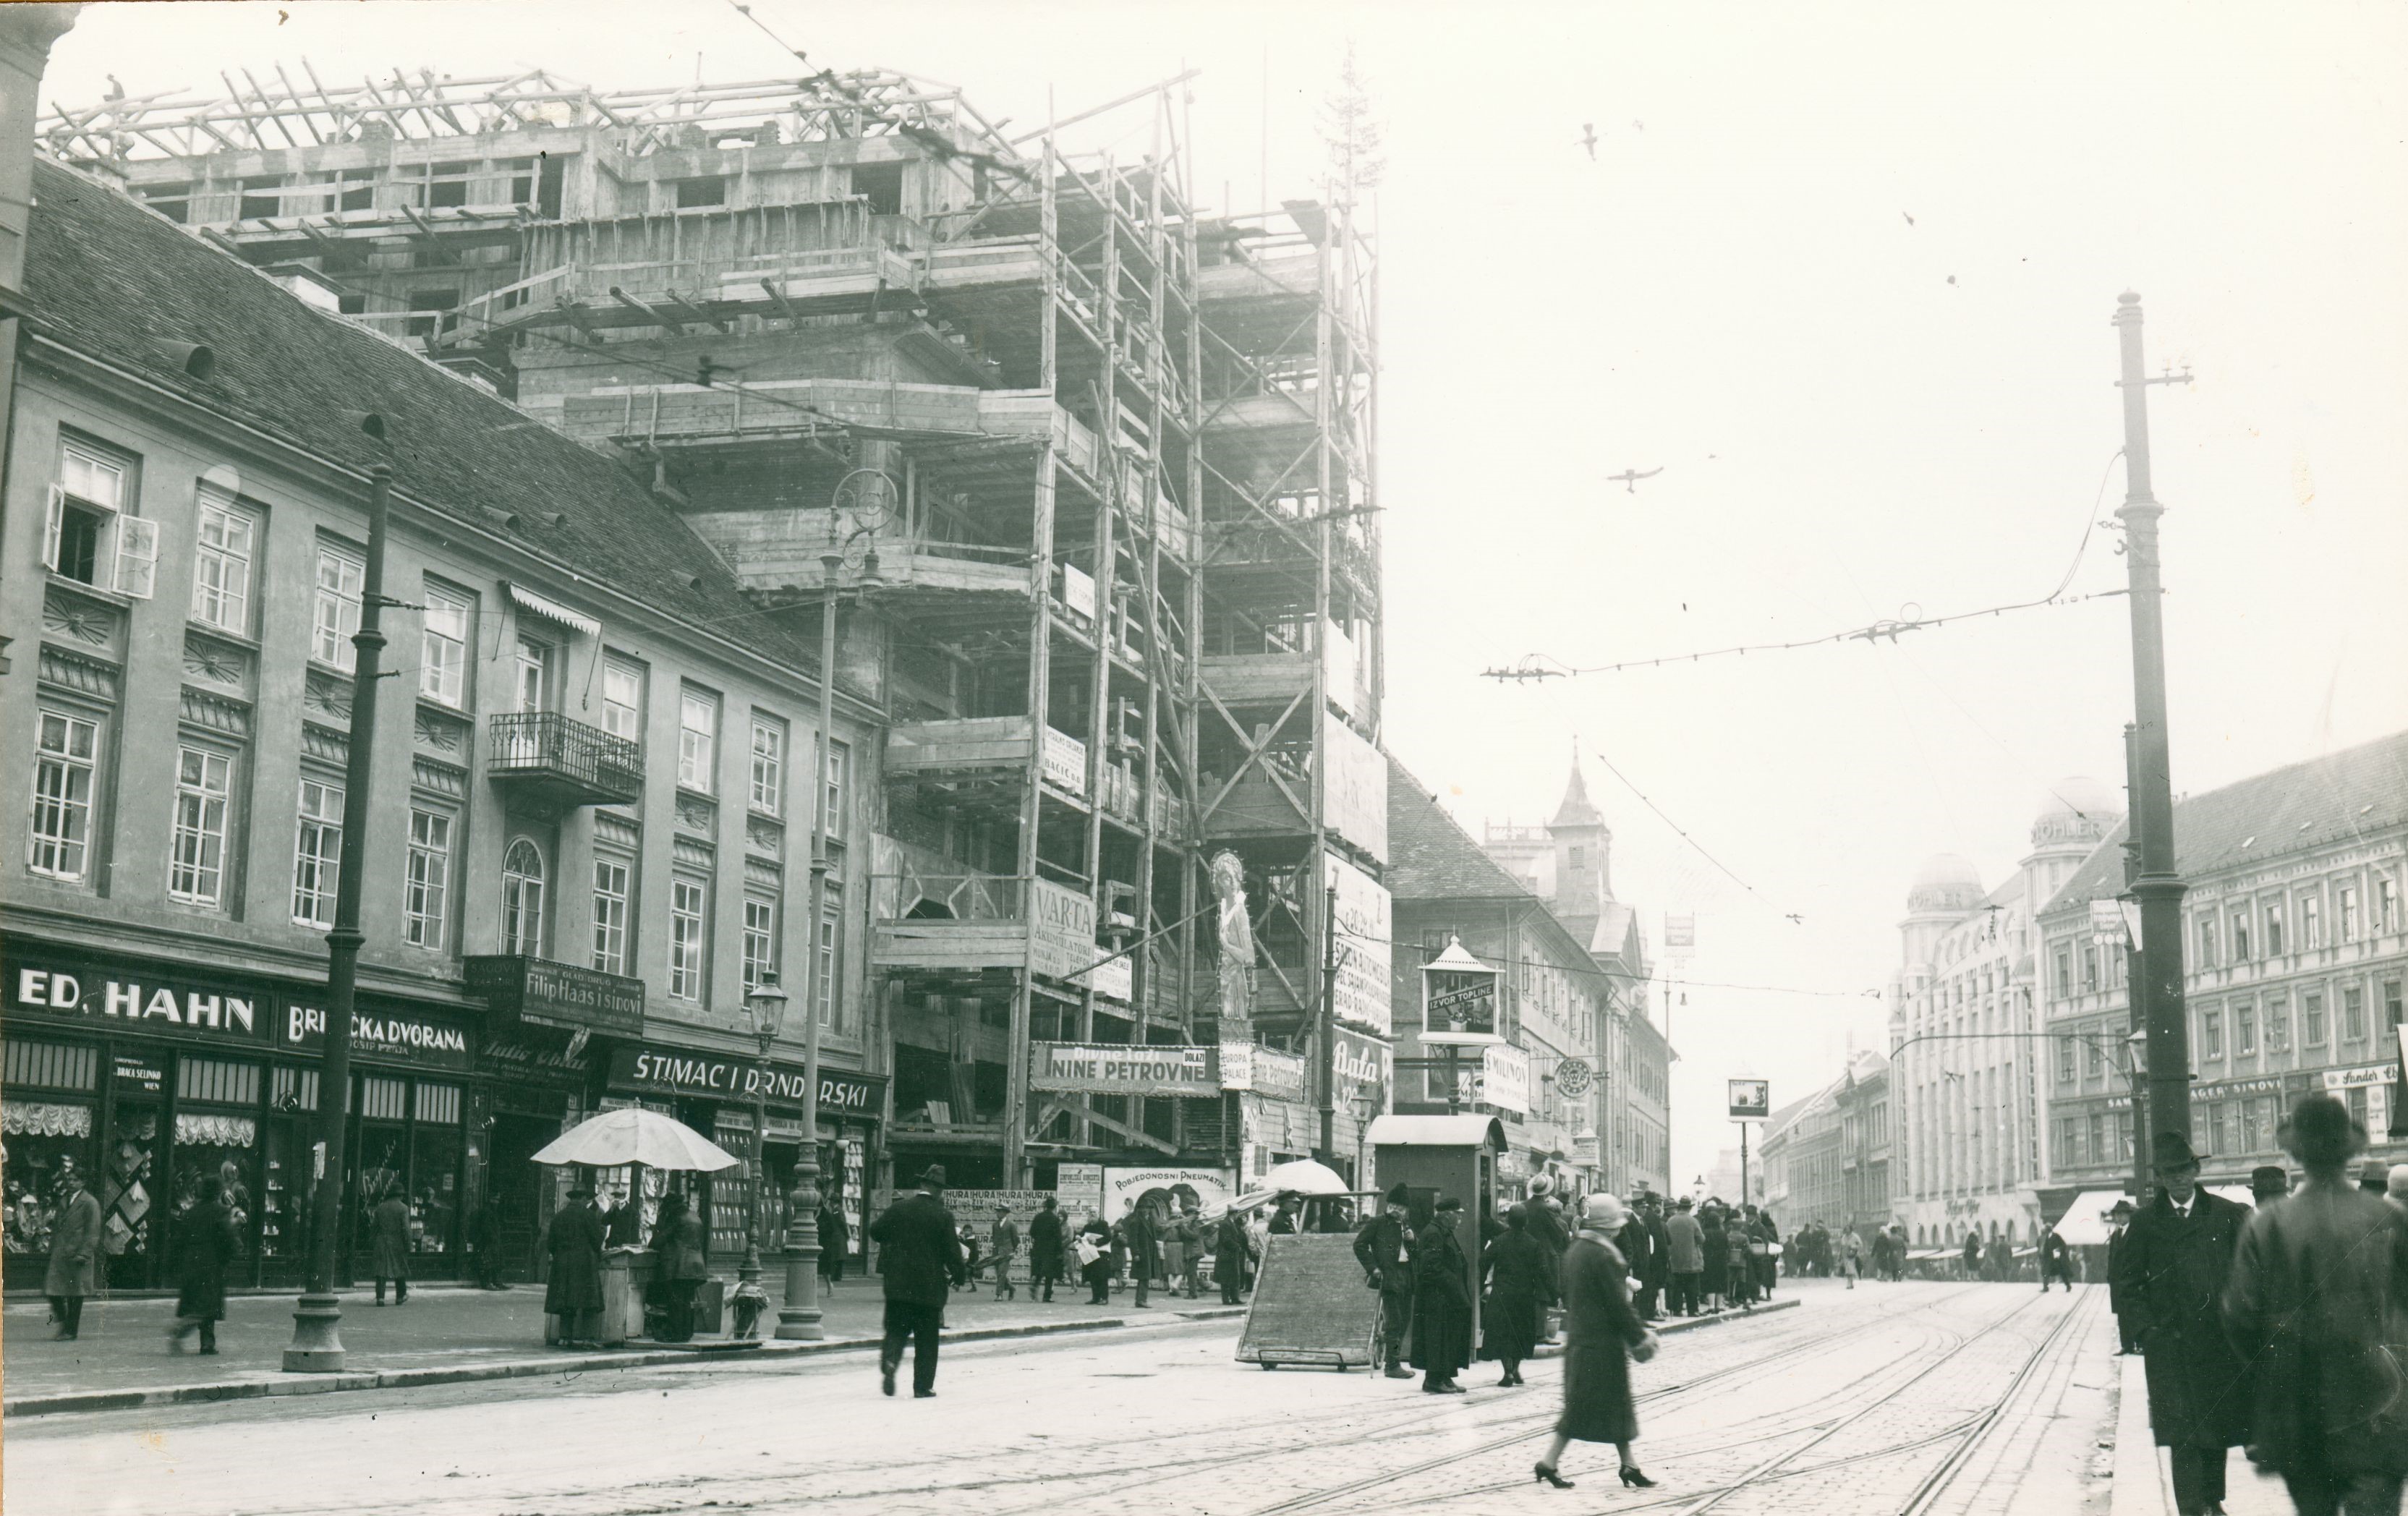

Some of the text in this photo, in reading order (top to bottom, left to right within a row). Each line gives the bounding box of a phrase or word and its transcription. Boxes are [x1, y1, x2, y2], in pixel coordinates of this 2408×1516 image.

[1036, 887, 1092, 936] VARTA
[1034, 924, 1091, 957] AKUMULATORI
[1066, 952, 1091, 968] TELEFON
[19, 968, 254, 1032] ED. HAHN
[526, 972, 557, 1004] Filip
[559, 979, 595, 1006] Haas
[597, 986, 602, 1007] i
[603, 989, 641, 1015] sinovi
[1429, 986, 1492, 1010] IZVOR TOPLINE
[289, 1006, 466, 1052] BRIČKA DVORANA
[1073, 1047, 1118, 1060] Divne
[1184, 1052, 1205, 1063] DOLAZI
[1222, 1053, 1248, 1063] EUROPA
[136, 1069, 161, 1080] SELINKO
[633, 1050, 868, 1107] ŠTIMAC I DRNDRSKI
[1052, 1060, 1205, 1082] NINE PETROVNE
[1224, 1068, 1247, 1079] PALACE
[144, 1081, 160, 1090] WIEN
[2233, 1080, 2281, 1094] SINOVI
[1115, 1170, 1228, 1191] POBJEDONOSNI PNEUMATIK
